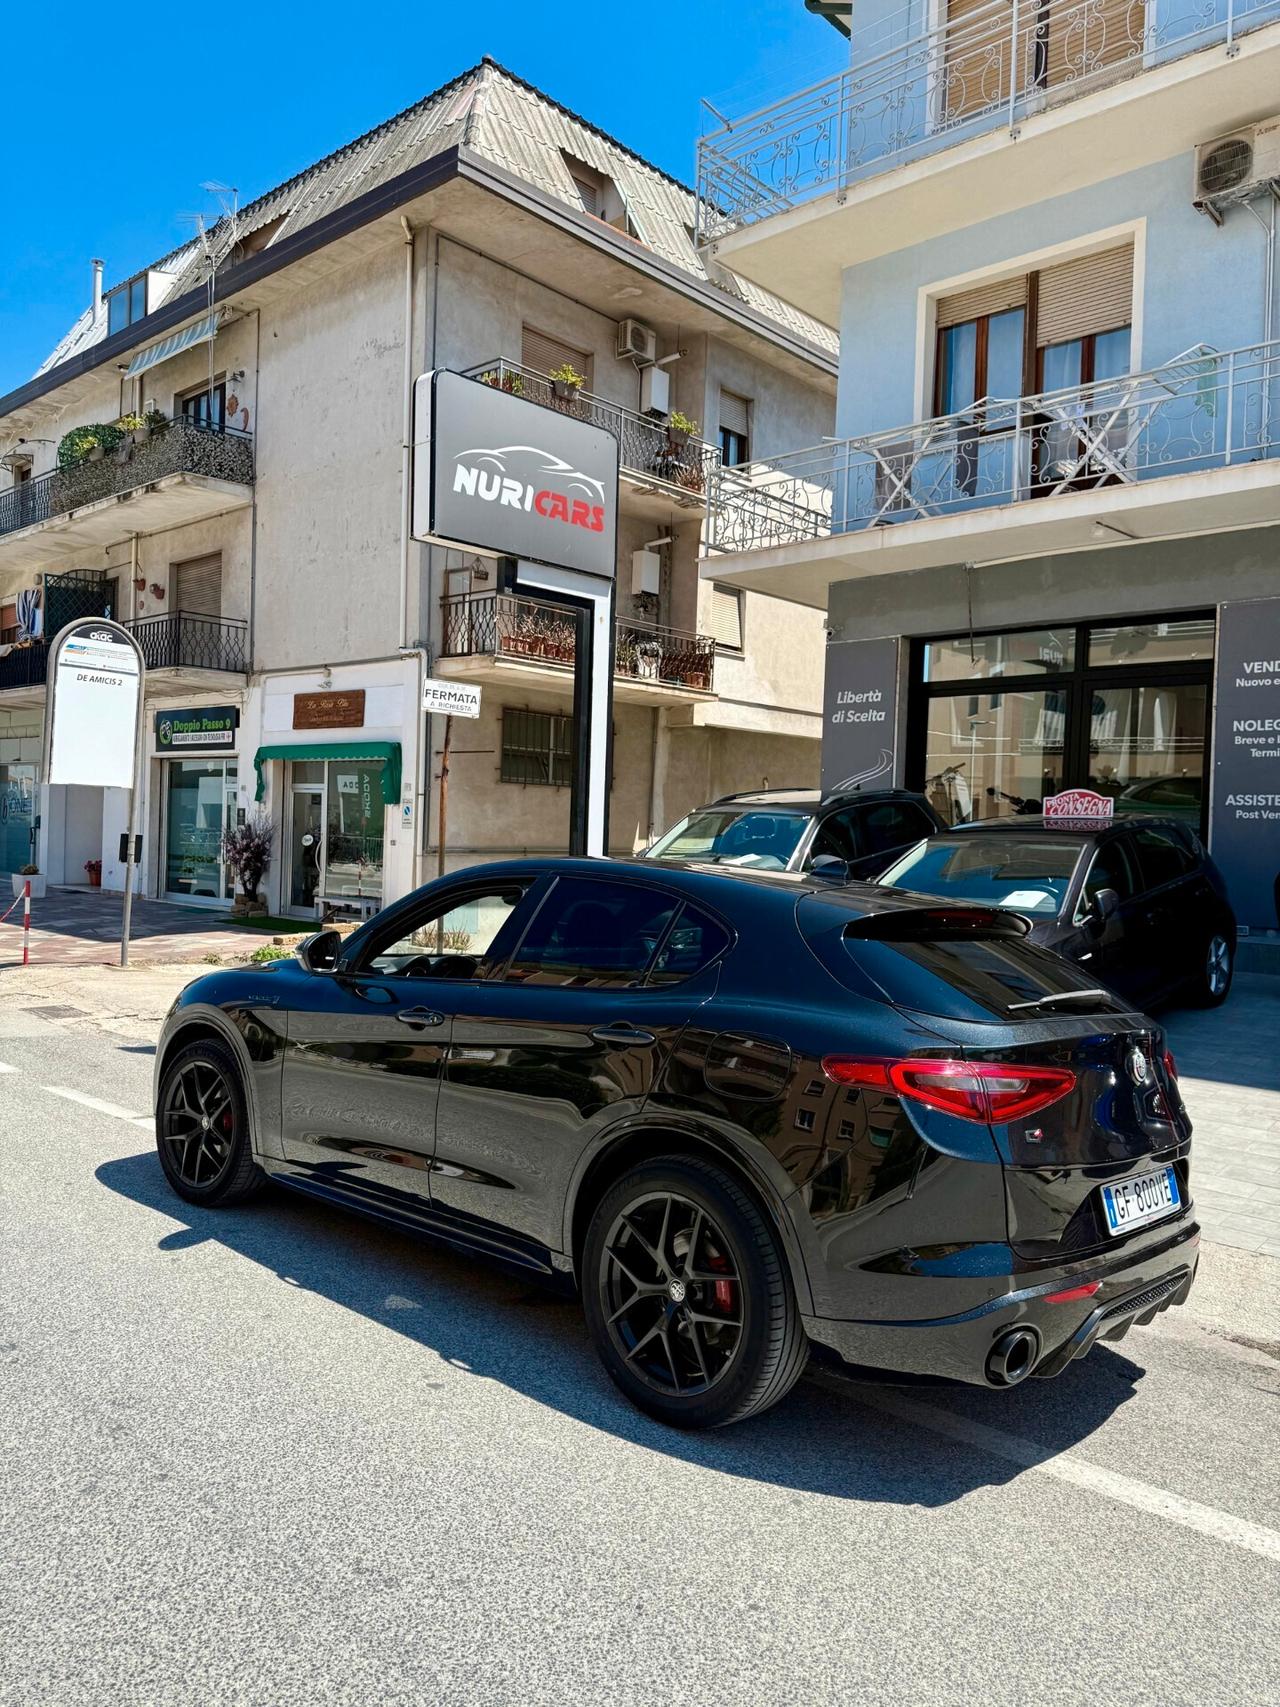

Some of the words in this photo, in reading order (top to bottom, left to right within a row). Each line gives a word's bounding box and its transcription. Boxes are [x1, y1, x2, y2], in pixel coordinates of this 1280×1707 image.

[452, 464, 605, 533] NURICARS
[76, 673, 89, 682] DE
[89, 675, 117, 685] AMICIS
[117, 679, 123, 687] 2
[1236, 678, 1272, 687] Nuovo
[425, 688, 478, 705] FERMATA
[837, 689, 882, 704] Libertà
[832, 710, 845, 723] di
[846, 709, 886, 722] Scelta
[173, 720, 201, 733] Doppio
[202, 718, 224, 730] Passo
[1235, 735, 1266, 745] Breve
[1046, 793, 1080, 808] PRONTA
[1050, 797, 1111, 815] CONSEGNA
[1236, 810, 1259, 819] Post
[1114, 1186, 1130, 1219] GF
[1134, 1172, 1172, 1212] 800VE
